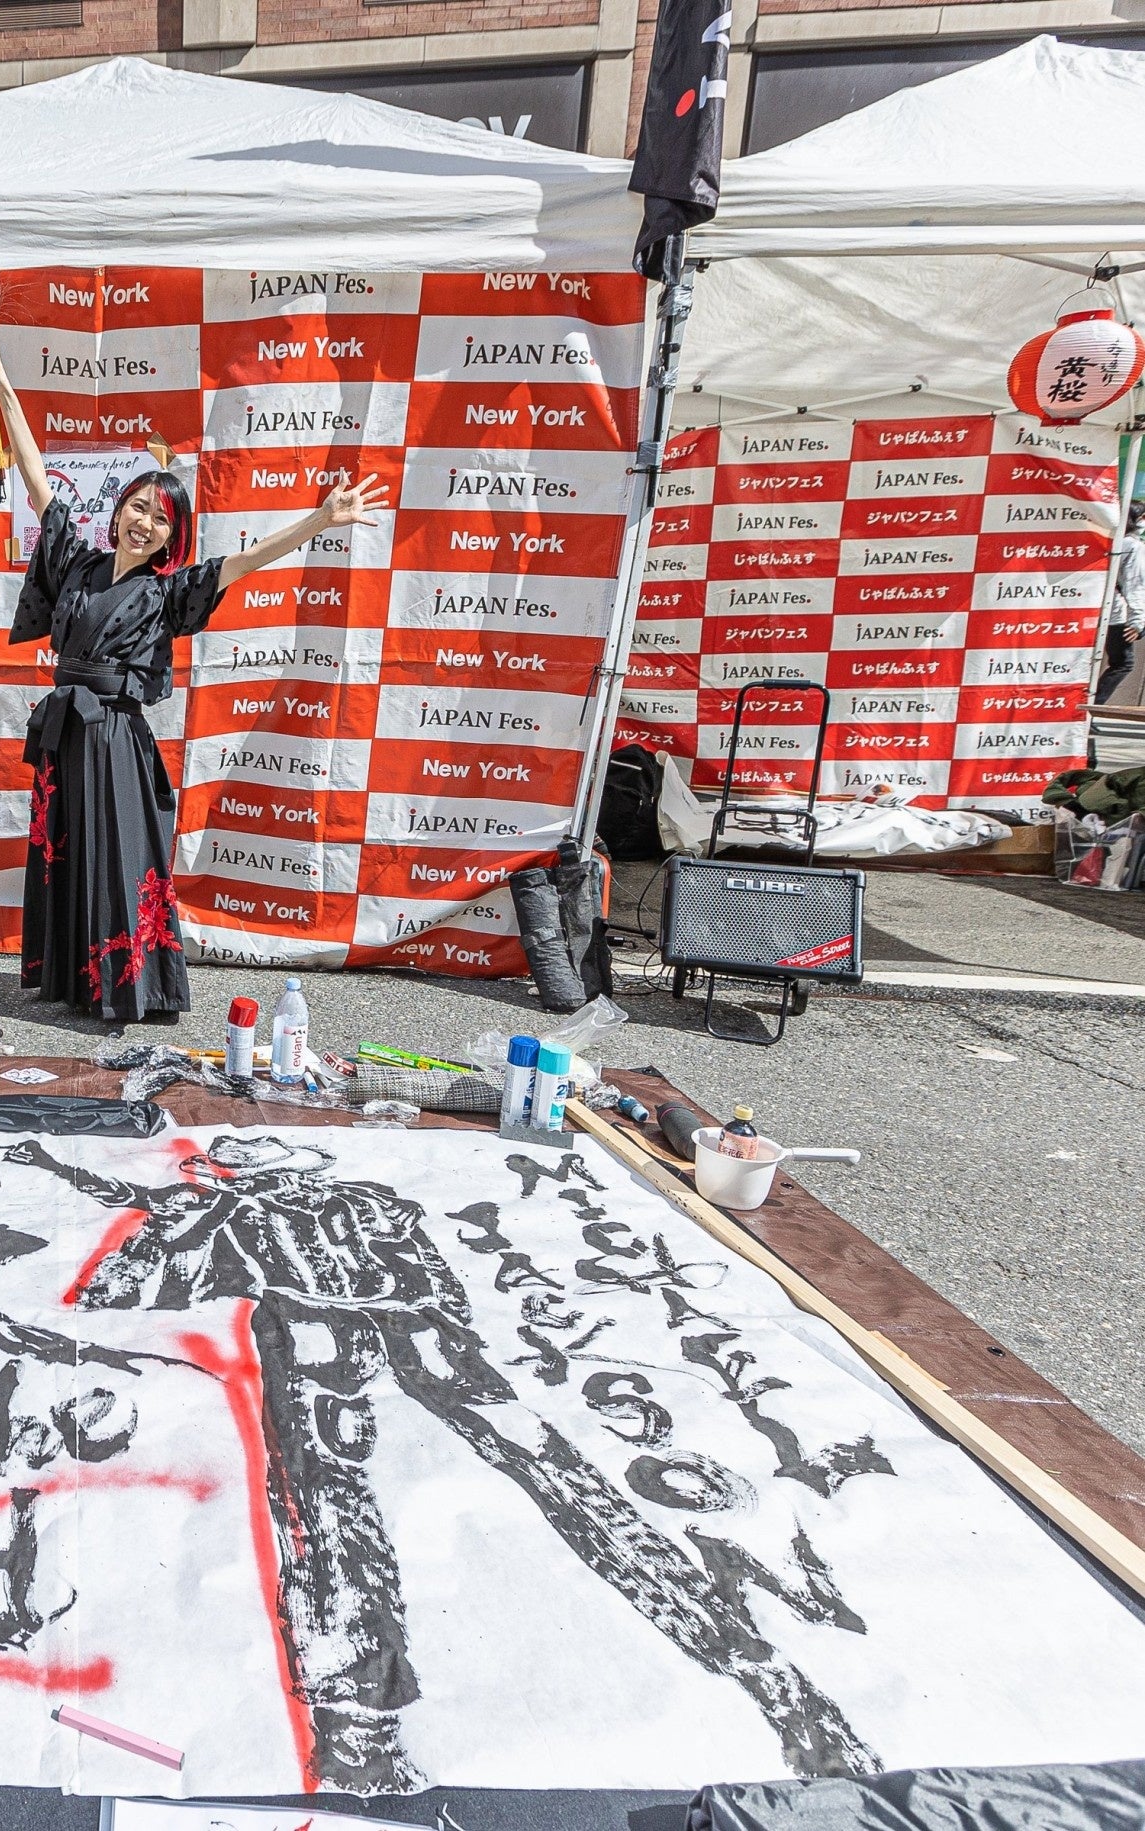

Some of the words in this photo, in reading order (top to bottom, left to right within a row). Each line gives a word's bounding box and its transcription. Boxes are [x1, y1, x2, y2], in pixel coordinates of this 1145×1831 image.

[483, 272, 535, 291] New
[545, 273, 591, 300] York
[49, 282, 94, 307] New
[102, 282, 149, 306] York
[258, 339, 305, 361] New
[314, 336, 363, 358] York
[1048, 356, 1098, 404] 黄桜
[465, 404, 520, 425] New
[527, 404, 585, 426] York
[46, 413, 92, 434] New
[100, 414, 152, 434] York
[879, 429, 969, 445] じゃぱんふぇす
[738, 475, 825, 490] ジャパンフェス
[866, 509, 958, 525] ジャパンフェス
[450, 531, 499, 551] New
[509, 532, 565, 554] York
[734, 552, 816, 566] じゃぱんふぇす
[1002, 545, 1089, 558] じゃぱんふぇす
[244, 588, 284, 609] New
[291, 587, 342, 606] York
[859, 586, 949, 600] じゃぱんふぇす
[725, 628, 808, 640] ジャパンフェス
[992, 622, 1080, 635] ジャパンフェス
[436, 649, 482, 669] New
[492, 650, 547, 672] York
[851, 661, 940, 675] じゃぱんふぇす
[720, 701, 804, 712] ジパンフェス
[982, 697, 1066, 710] ジャパンフェス
[845, 736, 929, 747] ジャパンフェス
[220, 797, 263, 819] New
[271, 803, 320, 825] York
[726, 878, 806, 895] CUBE
[821, 941, 851, 958] Street
[787, 951, 814, 965] Roland
[292, 1036, 302, 1067] evian
